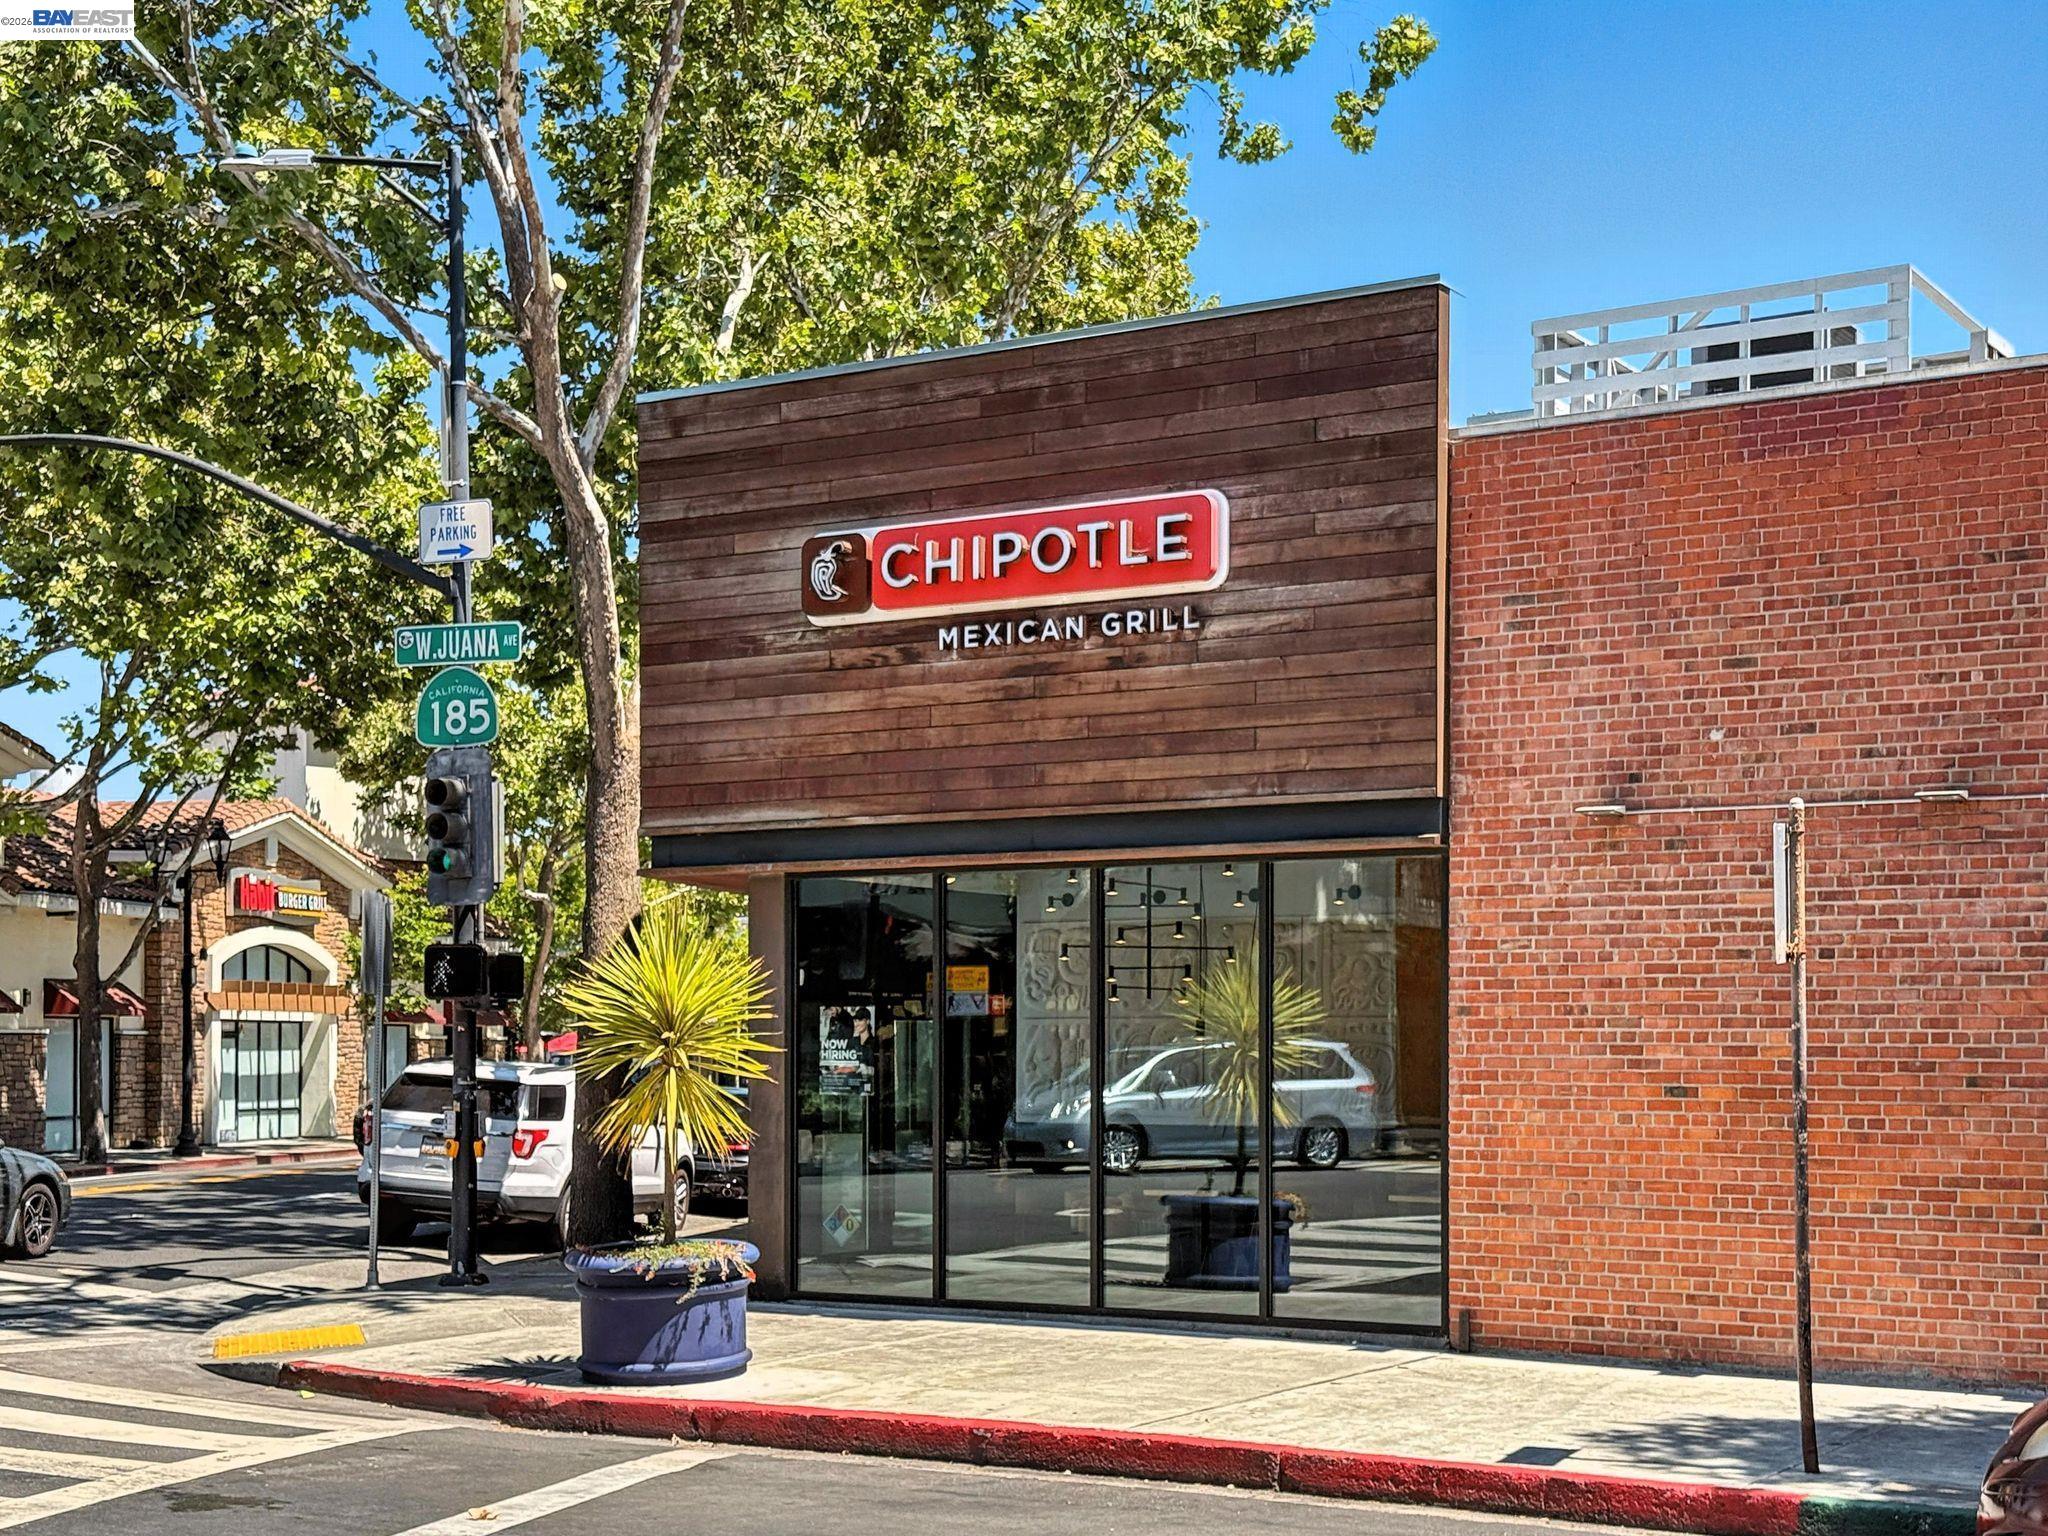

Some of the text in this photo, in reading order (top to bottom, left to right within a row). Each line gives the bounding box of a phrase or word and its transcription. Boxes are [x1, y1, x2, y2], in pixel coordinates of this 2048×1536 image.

[440, 506, 465, 522] FREE
[430, 524, 477, 542] PARKING
[880, 512, 1193, 588] CHIPOTLE
[938, 605, 1200, 650] MEXICAN GRILL
[503, 634, 518, 647] AVE
[428, 685, 485, 700] CALIFORNIA
[431, 698, 490, 736] 185
[278, 892, 307, 910] BURGER
[308, 895, 328, 911] GRILL
[821, 1039, 848, 1049] NOW
[821, 1050, 857, 1060] HIRING
